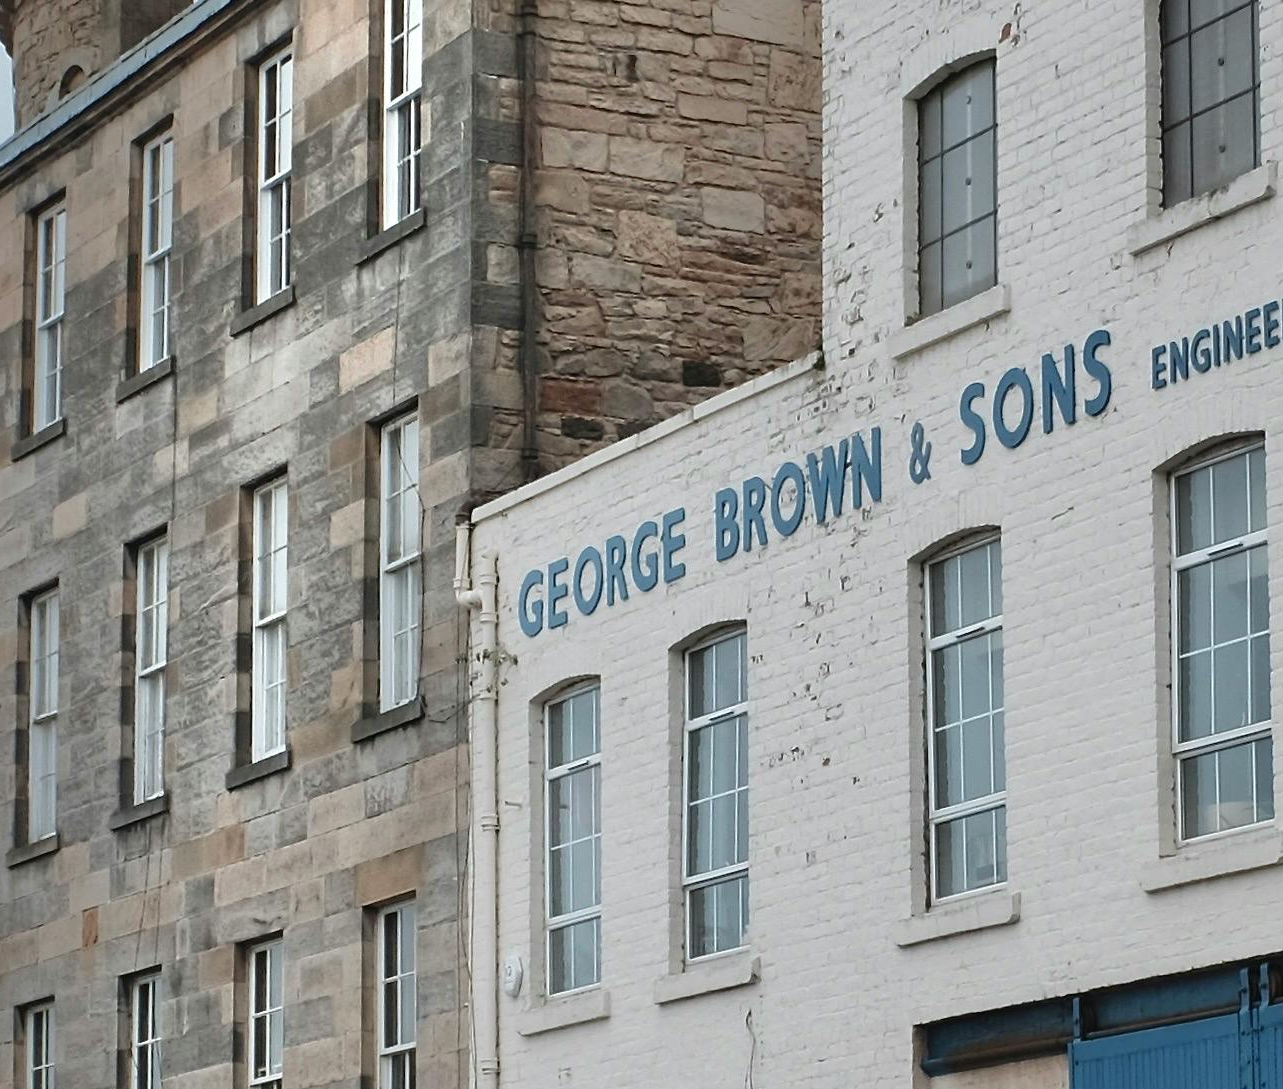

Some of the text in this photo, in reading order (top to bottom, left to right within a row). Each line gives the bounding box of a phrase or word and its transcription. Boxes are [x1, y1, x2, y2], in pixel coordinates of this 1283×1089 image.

[517, 506, 687, 638] GEORGE
[713, 426, 884, 564] BROWN
[908, 420, 933, 486] &
[958, 328, 1114, 466] SONS
